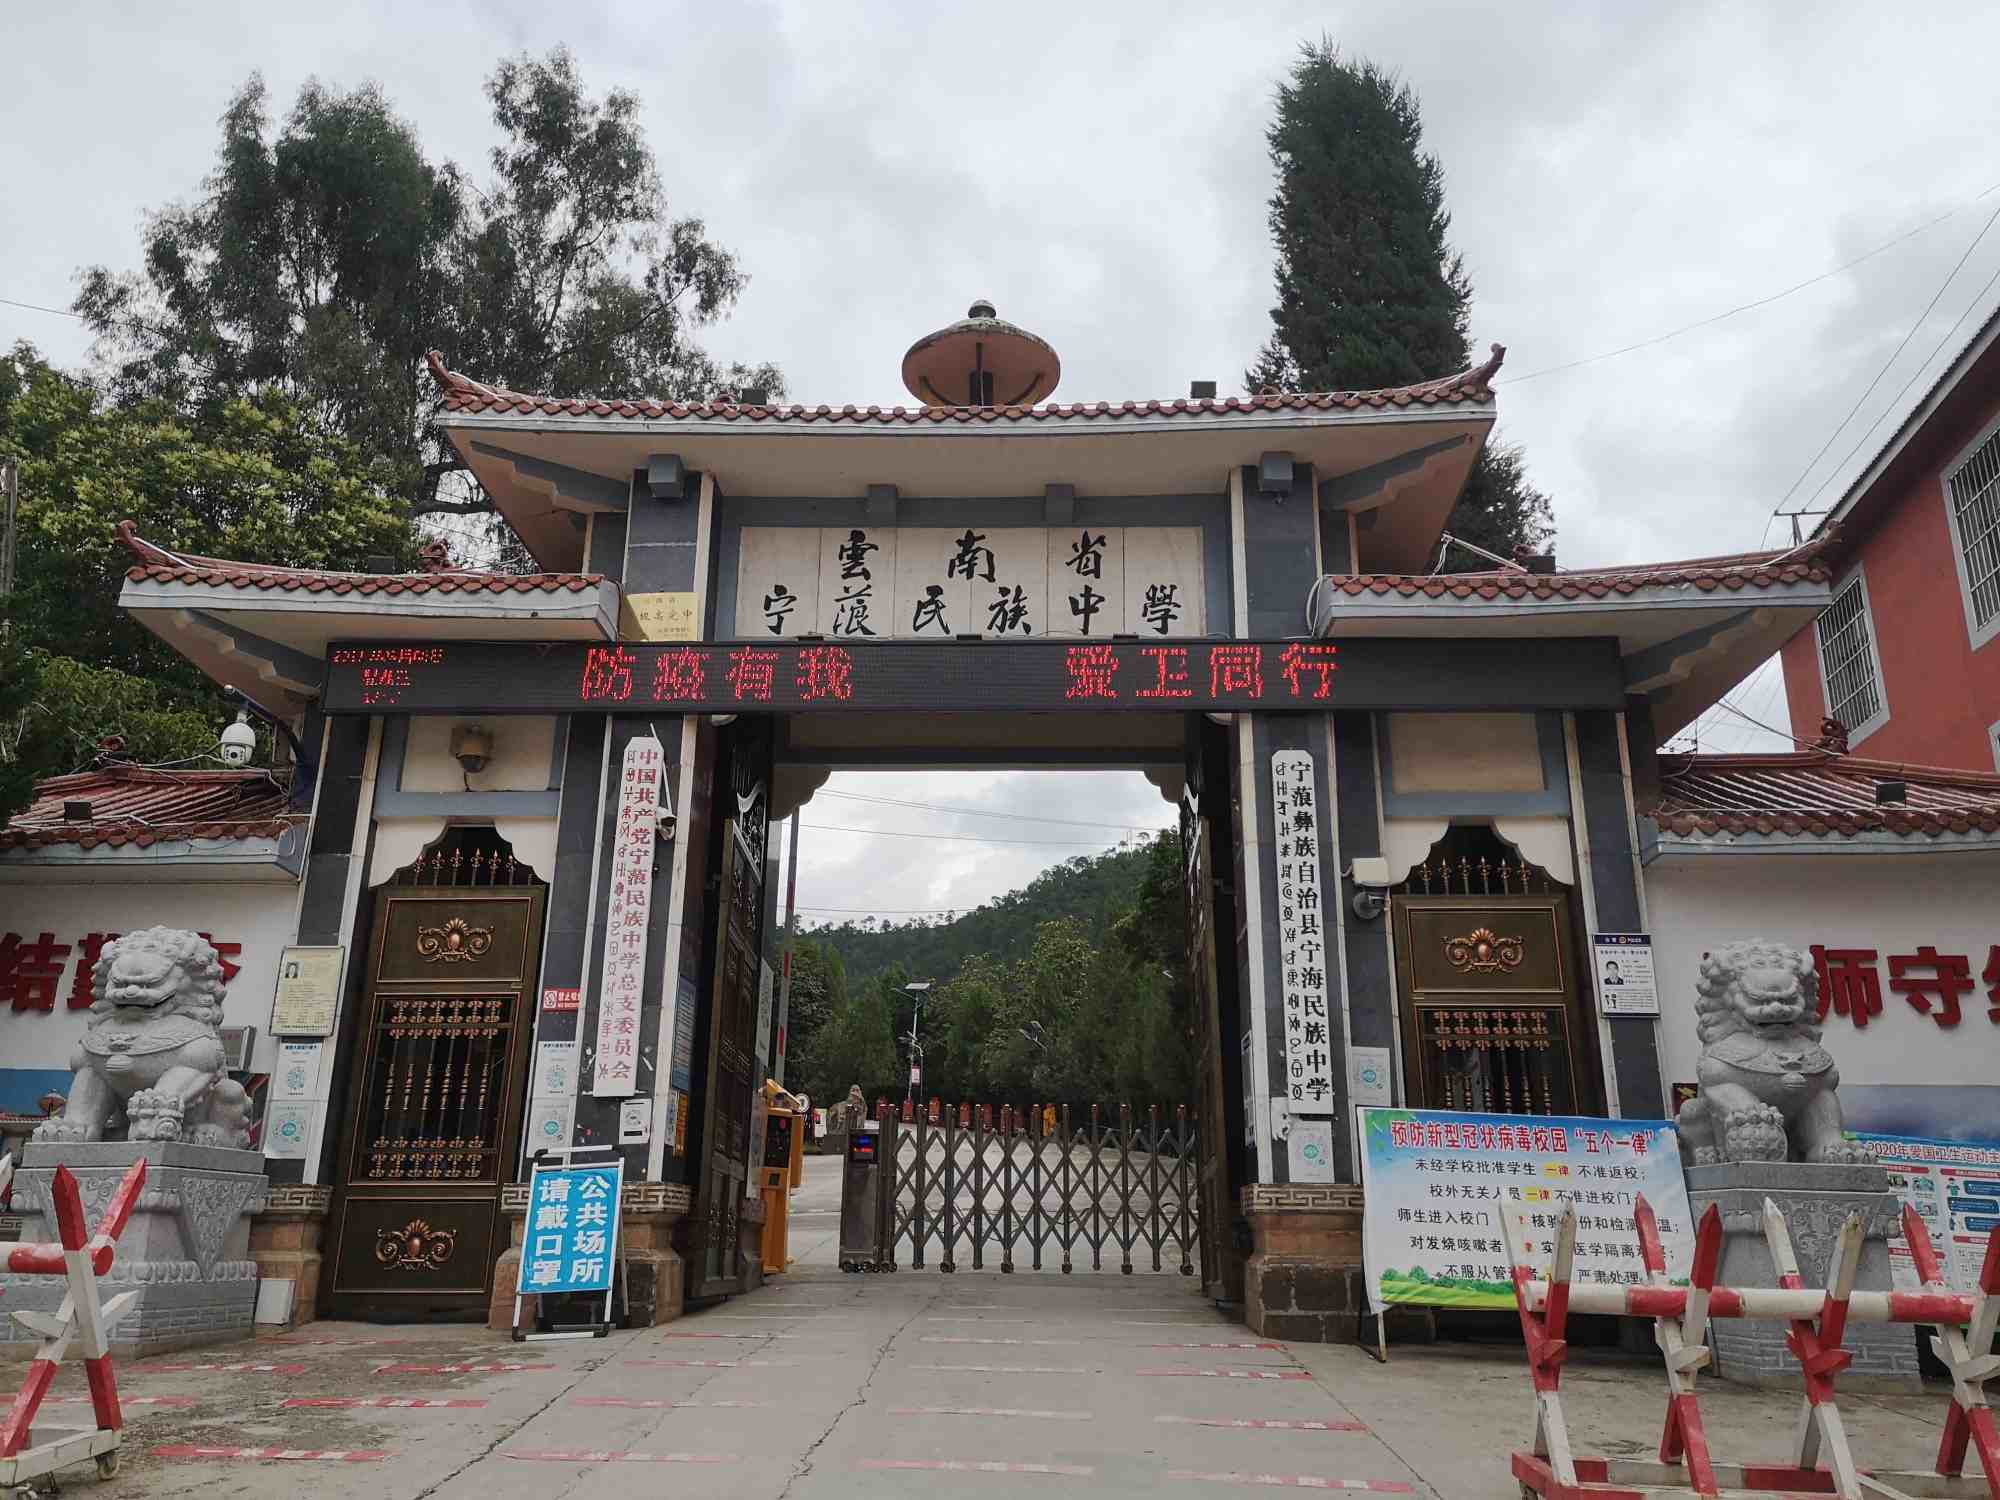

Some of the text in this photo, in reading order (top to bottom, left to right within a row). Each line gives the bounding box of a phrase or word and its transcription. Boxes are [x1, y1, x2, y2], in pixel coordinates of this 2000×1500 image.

[838, 530, 1106, 582] 雲南省
[583, 647, 852, 702] 防疫有我
[1290, 762, 1330, 1101] 宁蒗彝族自治县宁海民族中学
[530, 1179, 571, 1285] 请戴口罩
[569, 1176, 610, 1282] 公共场所
